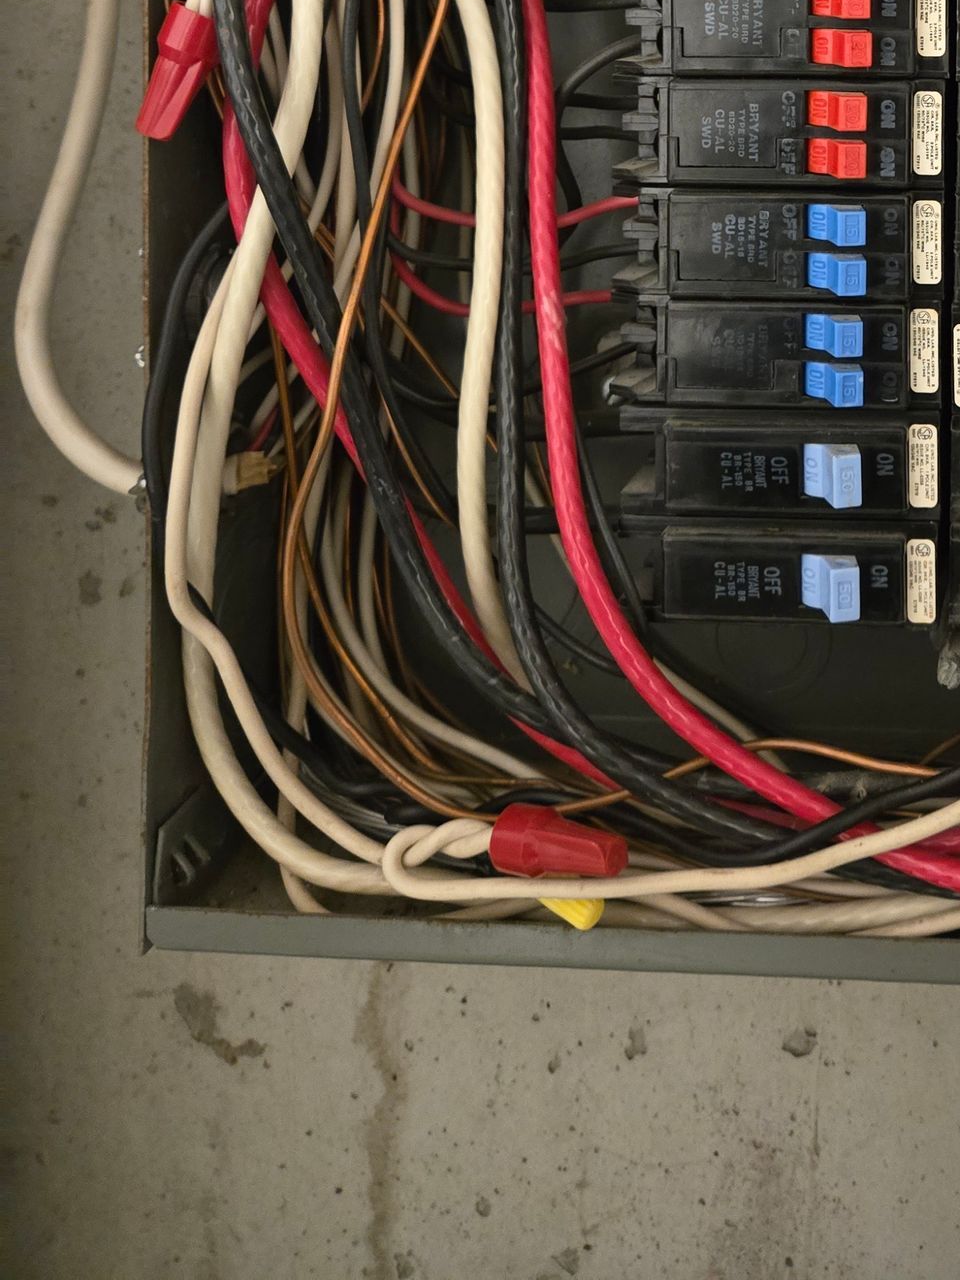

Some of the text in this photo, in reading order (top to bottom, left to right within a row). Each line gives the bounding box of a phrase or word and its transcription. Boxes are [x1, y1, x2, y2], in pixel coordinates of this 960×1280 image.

[704, 2, 715, 35] SWD
[881, 37, 896, 66] ON
[881, 100, 895, 128] ON
[701, 116, 712, 148] SWD
[749, 104, 759, 162] BRYANT
[880, 147, 895, 177] ON
[782, 204, 796, 240] OFF
[885, 209, 897, 236] ON
[711, 222, 722, 254] SWD
[758, 211, 768, 267] BRYANT
[885, 260, 899, 285] ON
[809, 322, 823, 341] ON
[882, 322, 897, 350] ON
[809, 370, 823, 390] ON
[721, 452, 732, 489] CU-AL
[755, 456, 766, 488] BRYANT
[772, 456, 789, 484] OFF
[805, 457, 818, 483] ON
[877, 453, 894, 476] ON
[745, 480, 752, 492] BR
[841, 471, 853, 491] 50
[714, 562, 726, 600] CU-AL
[748, 565, 759, 599] BRYANT
[764, 567, 781, 596] OFF
[804, 567, 816, 593] ON
[871, 565, 888, 588] ON
[737, 590, 745, 602] BR
[839, 584, 850, 603] 50
